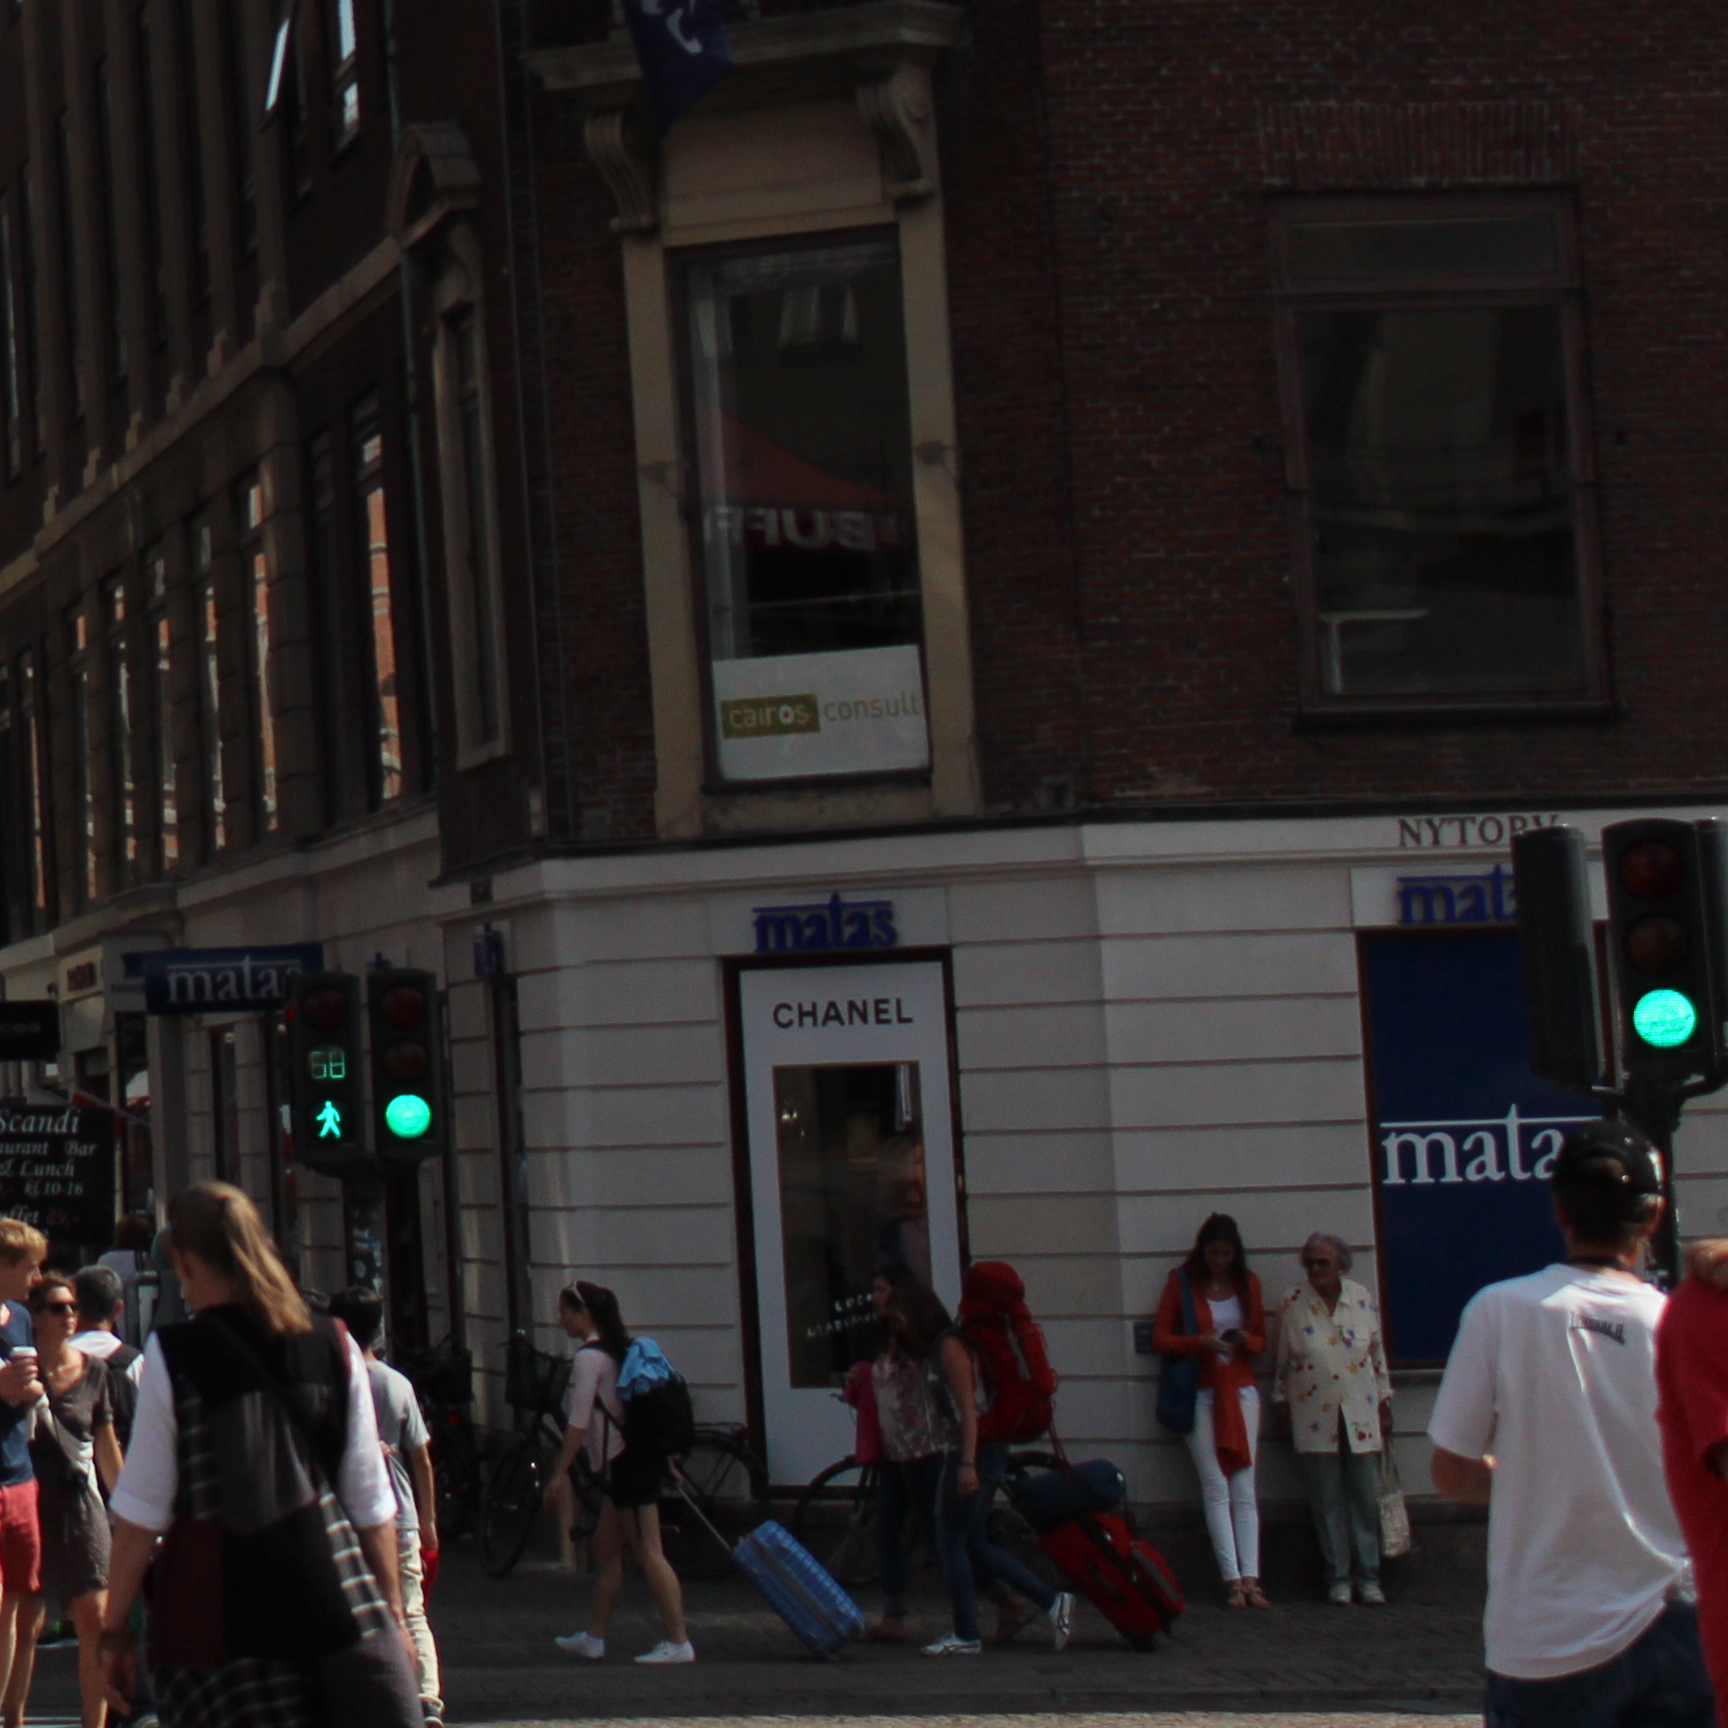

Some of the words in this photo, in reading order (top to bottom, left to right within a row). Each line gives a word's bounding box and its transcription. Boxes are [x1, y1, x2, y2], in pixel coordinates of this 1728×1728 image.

[729, 703, 810, 729] cairos
[822, 690, 920, 723] consult
[752, 893, 897, 955] matas
[772, 996, 914, 1030] CHANEL
[64, 1138, 98, 1157] Bar
[19, 1158, 76, 1178] Lunch
